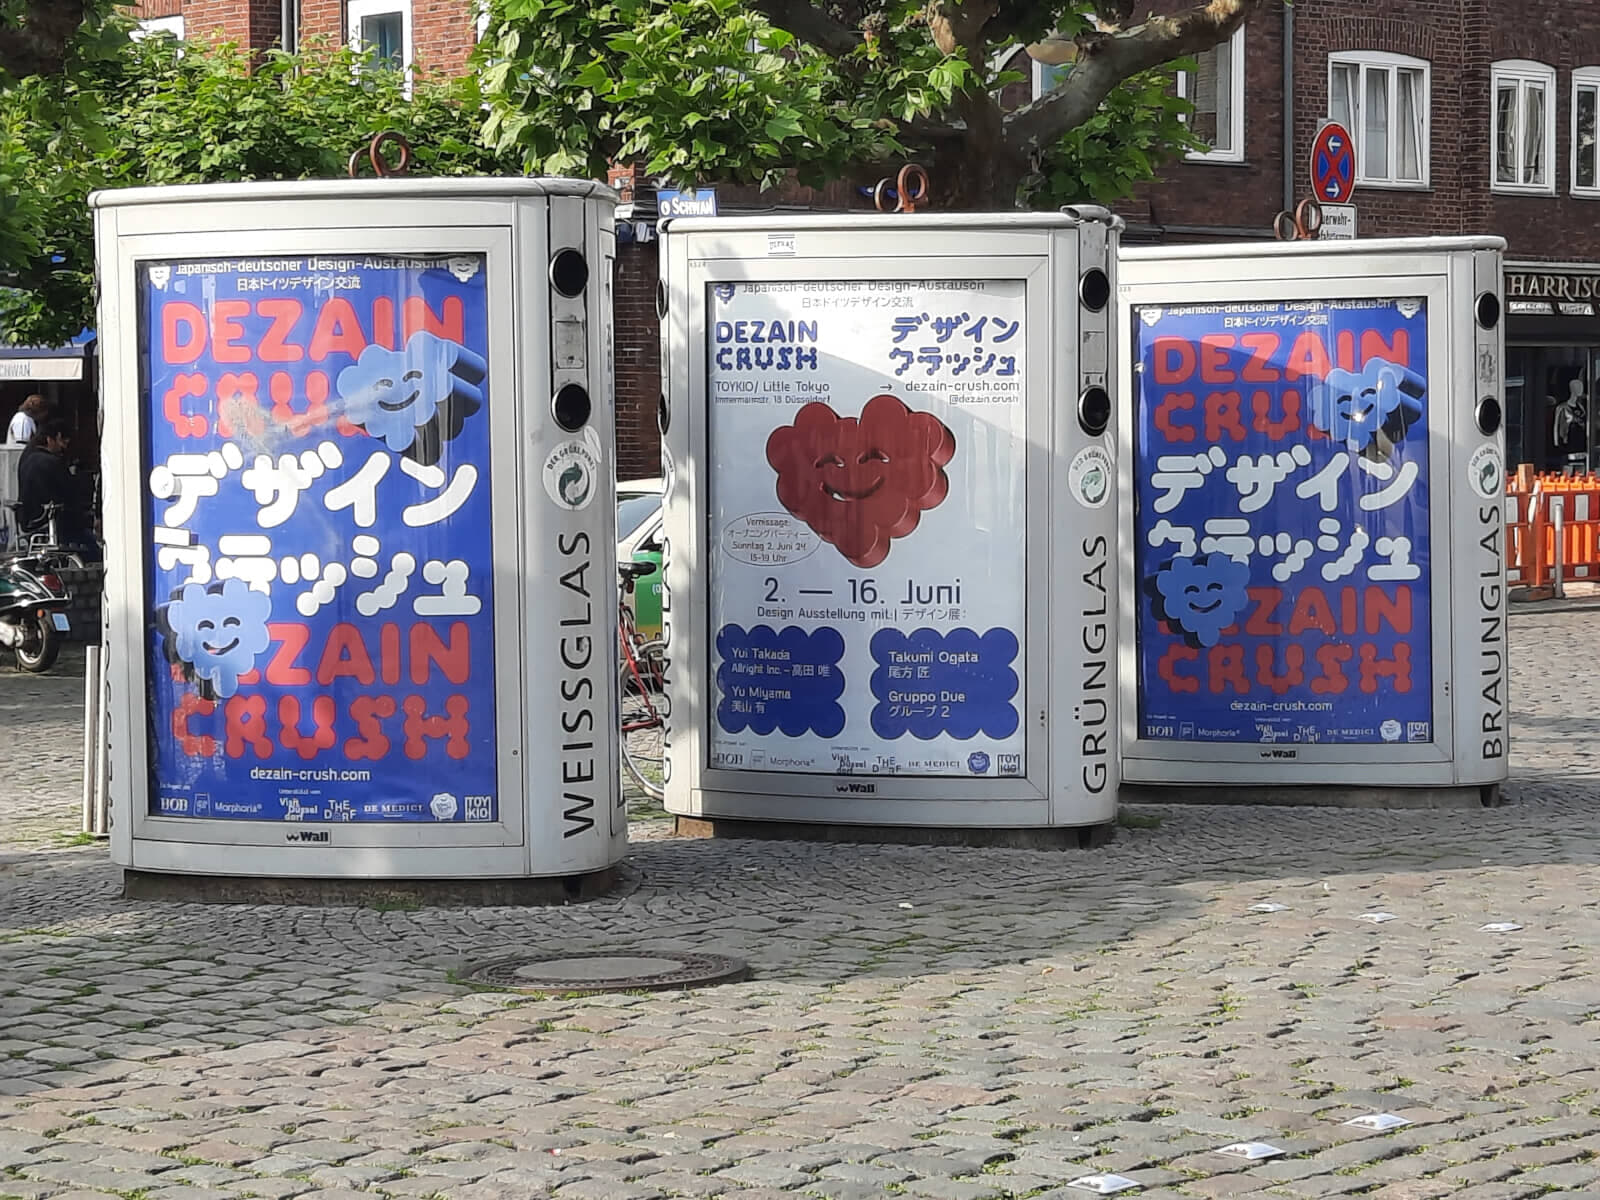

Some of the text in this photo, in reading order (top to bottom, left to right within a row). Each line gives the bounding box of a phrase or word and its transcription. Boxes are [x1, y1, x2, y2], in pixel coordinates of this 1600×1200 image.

[237, 275, 361, 291] 日本ドイツデザイン交流
[161, 297, 465, 364] DEZAIN
[716, 320, 818, 343] DEZAIN
[891, 312, 1020, 343] デザイン
[716, 347, 818, 370] CRUSH
[888, 347, 1017, 376] クラッシュ
[1153, 329, 1409, 384] DEZAIN
[763, 380, 791, 392] Little
[796, 380, 830, 394] Tokyo
[905, 380, 1020, 392] dezain-crush.com
[164, 370, 370, 438] CRU
[1154, 388, 1331, 442] CRU
[150, 441, 478, 528] デザイン
[1151, 444, 1419, 514] デザイン
[764, 577, 786, 602] 2.
[848, 579, 885, 604] 16.
[901, 578, 960, 604] Juni
[757, 606, 794, 620] Design
[799, 607, 865, 621] Ausstellung
[1158, 584, 1412, 635] ZAIN
[1480, 505, 1502, 760] BRAUNGLAS
[170, 621, 470, 686] ZAIN
[732, 647, 790, 660] Yui Takada
[888, 651, 978, 665] Takumi Ogata
[1074, 535, 1107, 794] GRÜNGLAS
[1158, 642, 1412, 694] CRUSH
[558, 531, 595, 838] WEISSGLAS
[732, 686, 745, 697] Yu
[888, 690, 966, 704] Gruppo Due
[1231, 700, 1332, 711] dezain-crush.com
[172, 695, 470, 760] CRUSH
[250, 767, 371, 782] dezain-crush.com
[328, 799, 350, 812] THE
[467, 797, 488, 808] TOY
[301, 831, 329, 842] Wall
